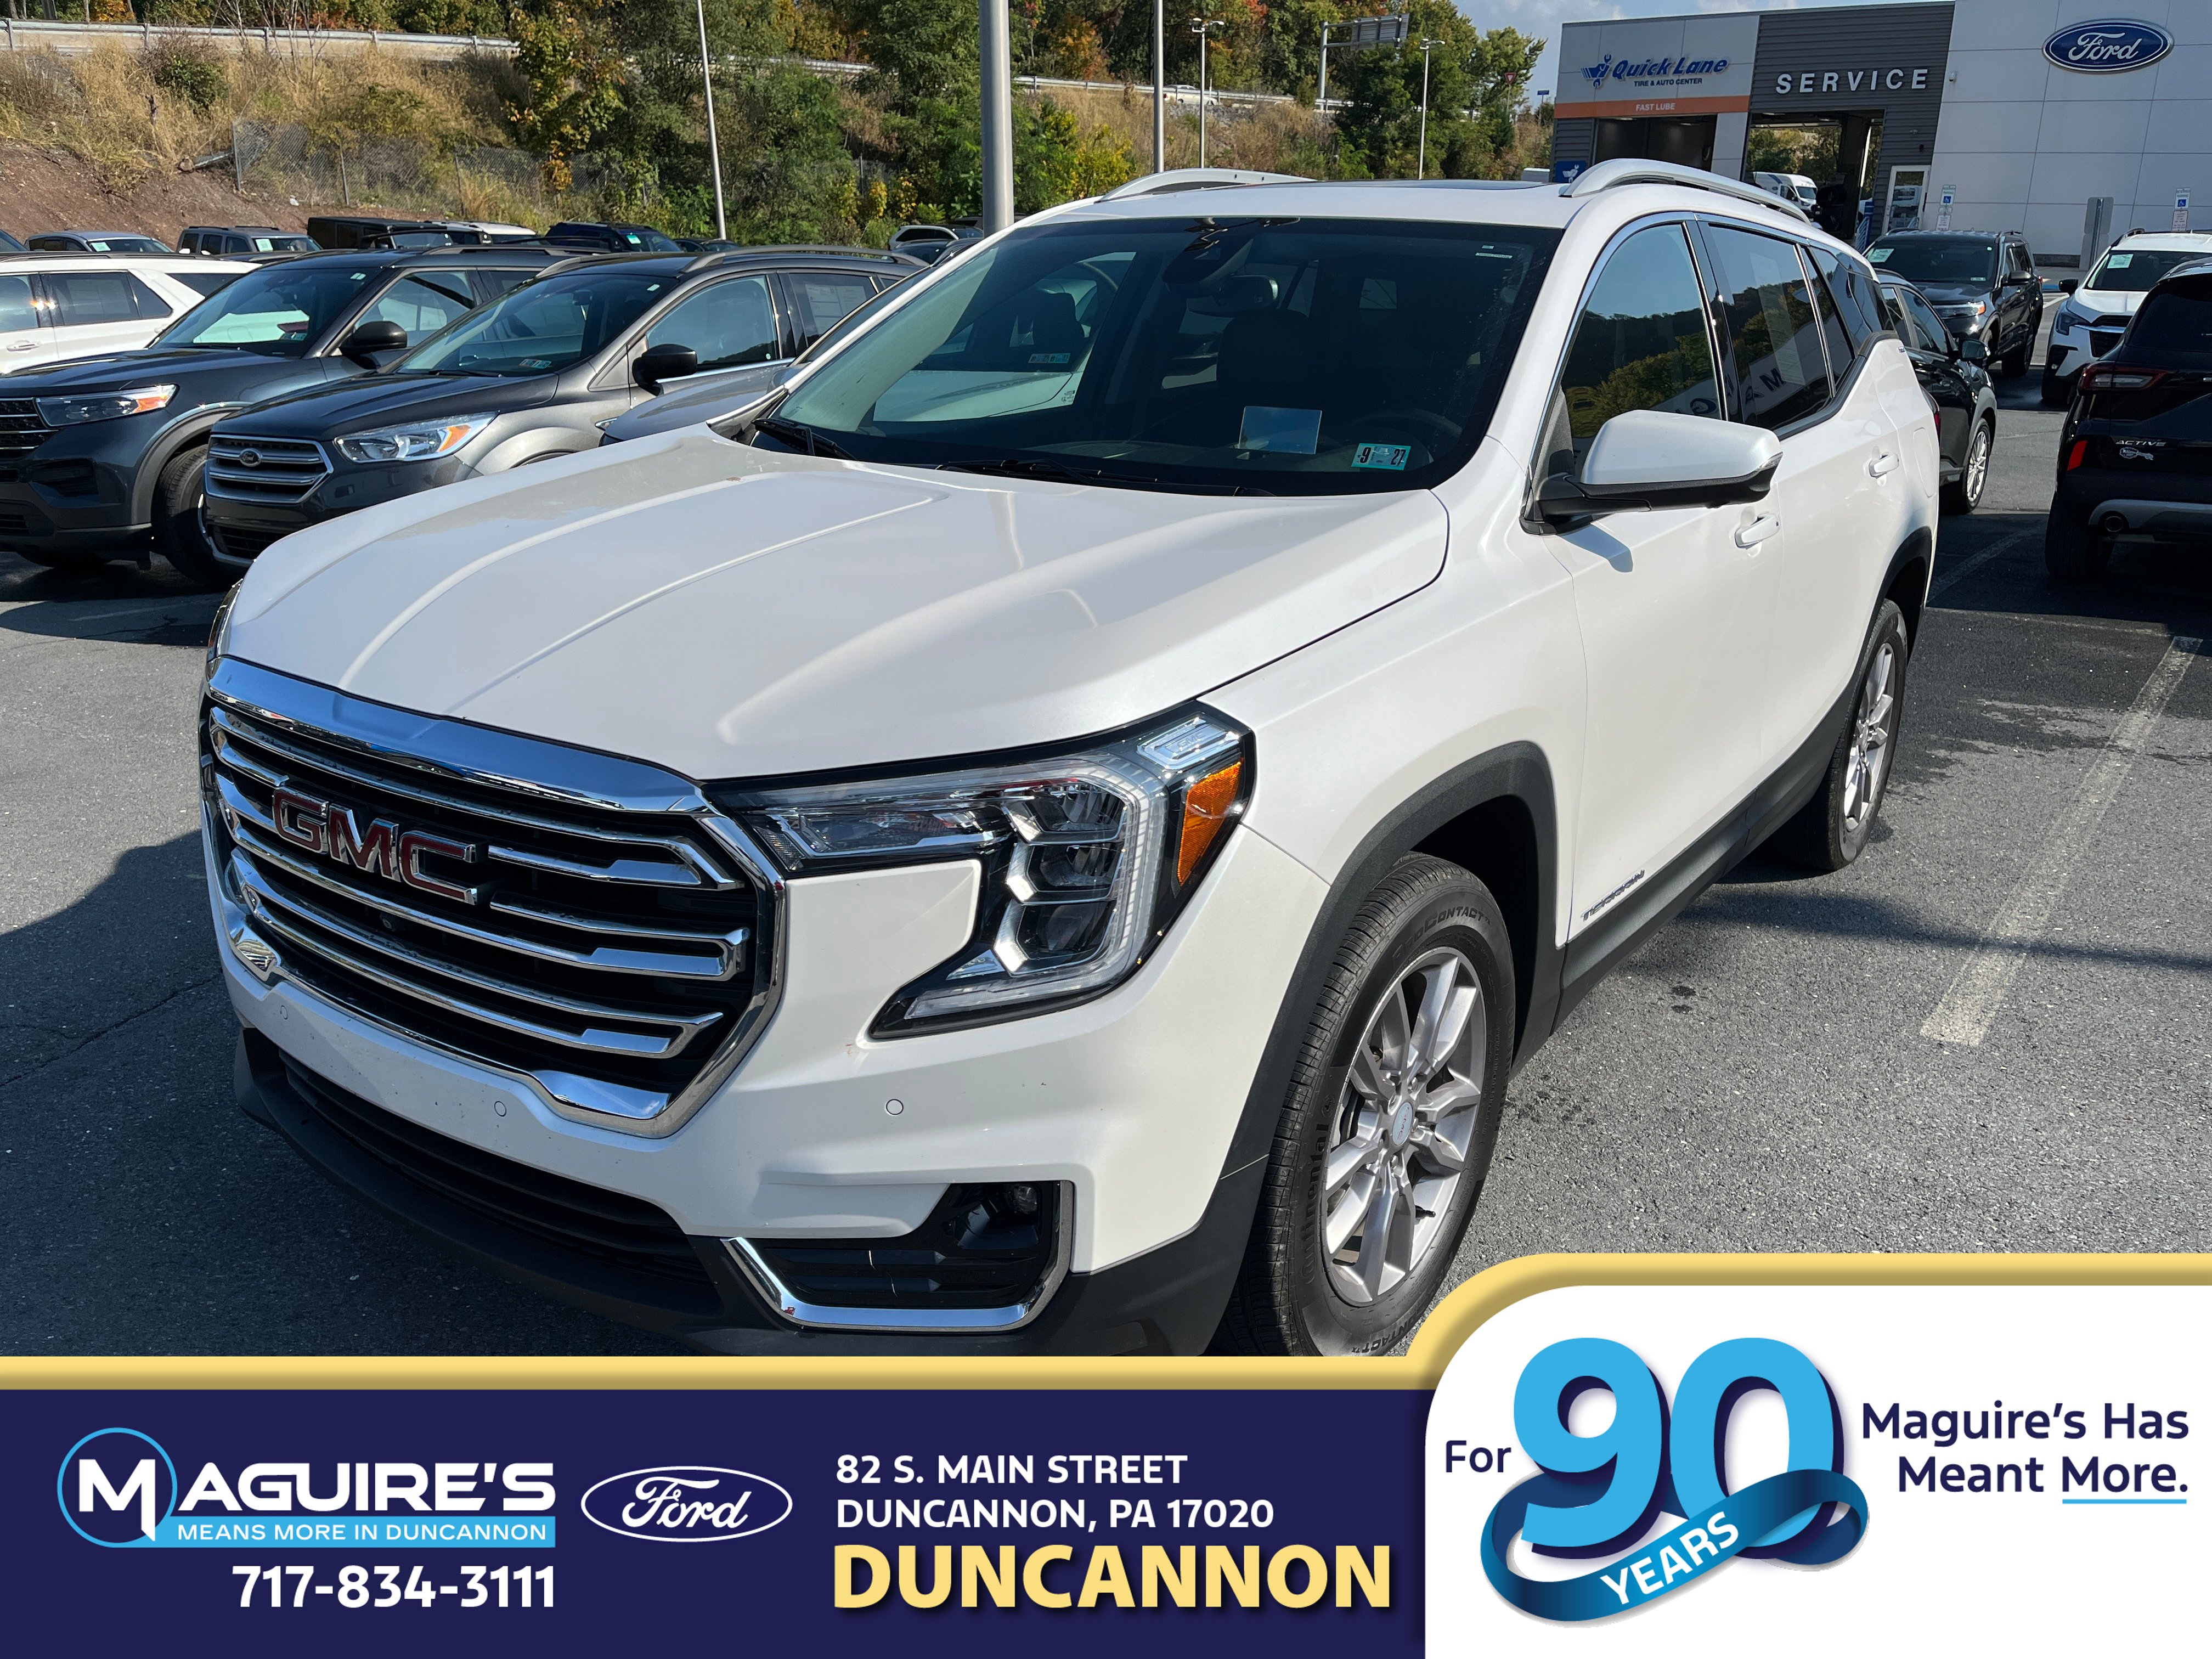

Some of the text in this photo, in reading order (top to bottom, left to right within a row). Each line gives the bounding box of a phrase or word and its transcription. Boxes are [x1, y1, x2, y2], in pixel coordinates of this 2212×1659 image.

[2068, 32, 2142, 61] Ford
[1612, 57, 1728, 80] Quick Lane
[1775, 69, 1928, 94] SERVICE
[1359, 447, 1406, 467] 9 27
[1177, 731, 1206, 749] GMC
[271, 786, 478, 905] GMC
